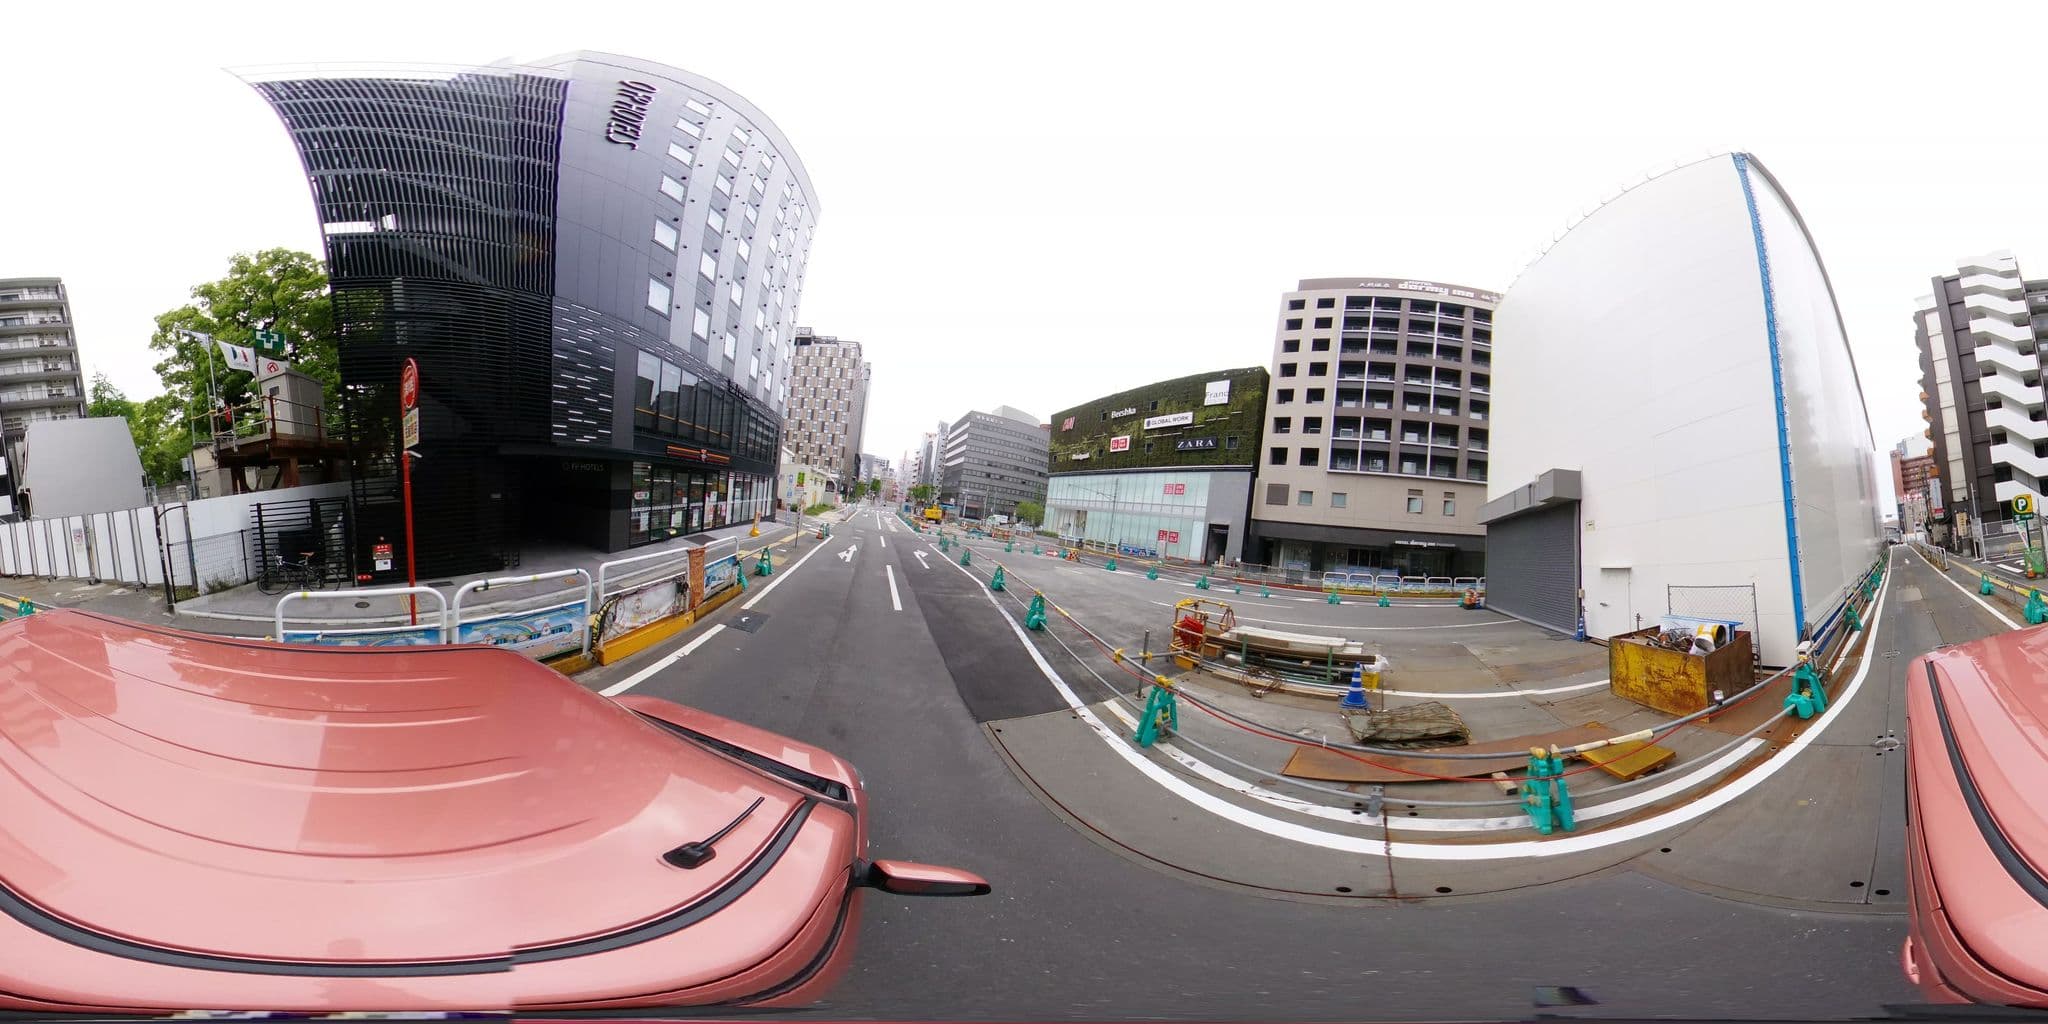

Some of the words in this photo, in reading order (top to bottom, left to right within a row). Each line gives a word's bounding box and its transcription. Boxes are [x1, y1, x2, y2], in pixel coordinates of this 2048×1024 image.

[1398, 281, 1449, 296] dormy
[1111, 408, 1137, 418] Bershka
[1151, 417, 1172, 426] GLOBAL
[1172, 415, 1190, 424] WORK
[1177, 439, 1214, 449] ZARA
[2018, 499, 2026, 510] P
